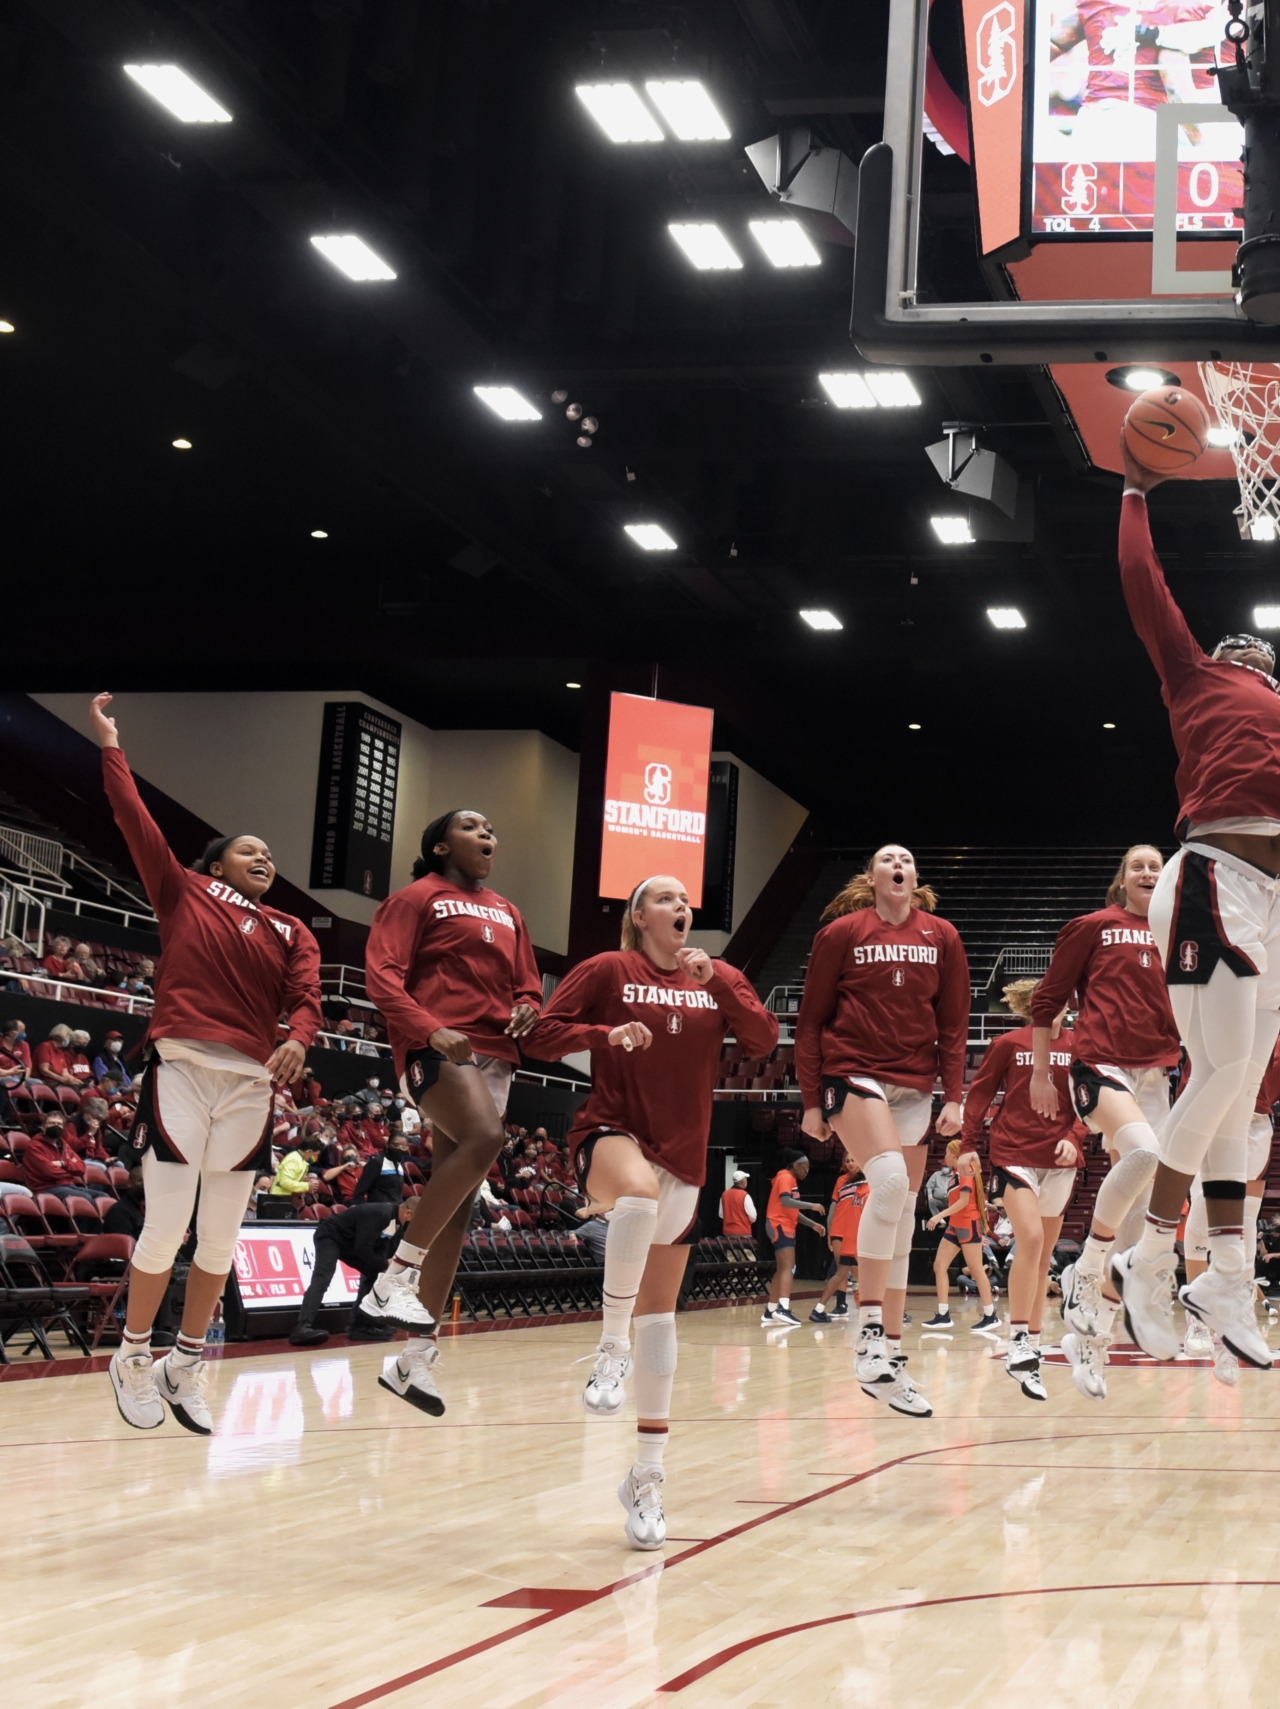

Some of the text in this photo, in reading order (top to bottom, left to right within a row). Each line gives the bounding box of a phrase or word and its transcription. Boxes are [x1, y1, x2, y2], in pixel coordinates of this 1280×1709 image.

[1189, 162, 1219, 207] 0
[1043, 217, 1101, 232] TOL 4
[1223, 214, 1234, 228] 0
[322, 705, 347, 885] STANFORD WOMEN'S BASKETBALL
[605, 799, 705, 835] STANFORD
[608, 824, 701, 844] WOMEN'S BASKETBALL
[853, 944, 938, 965] STANFORD
[268, 1246, 283, 1272] 0
[270, 1283, 300, 1294] FLS 0
